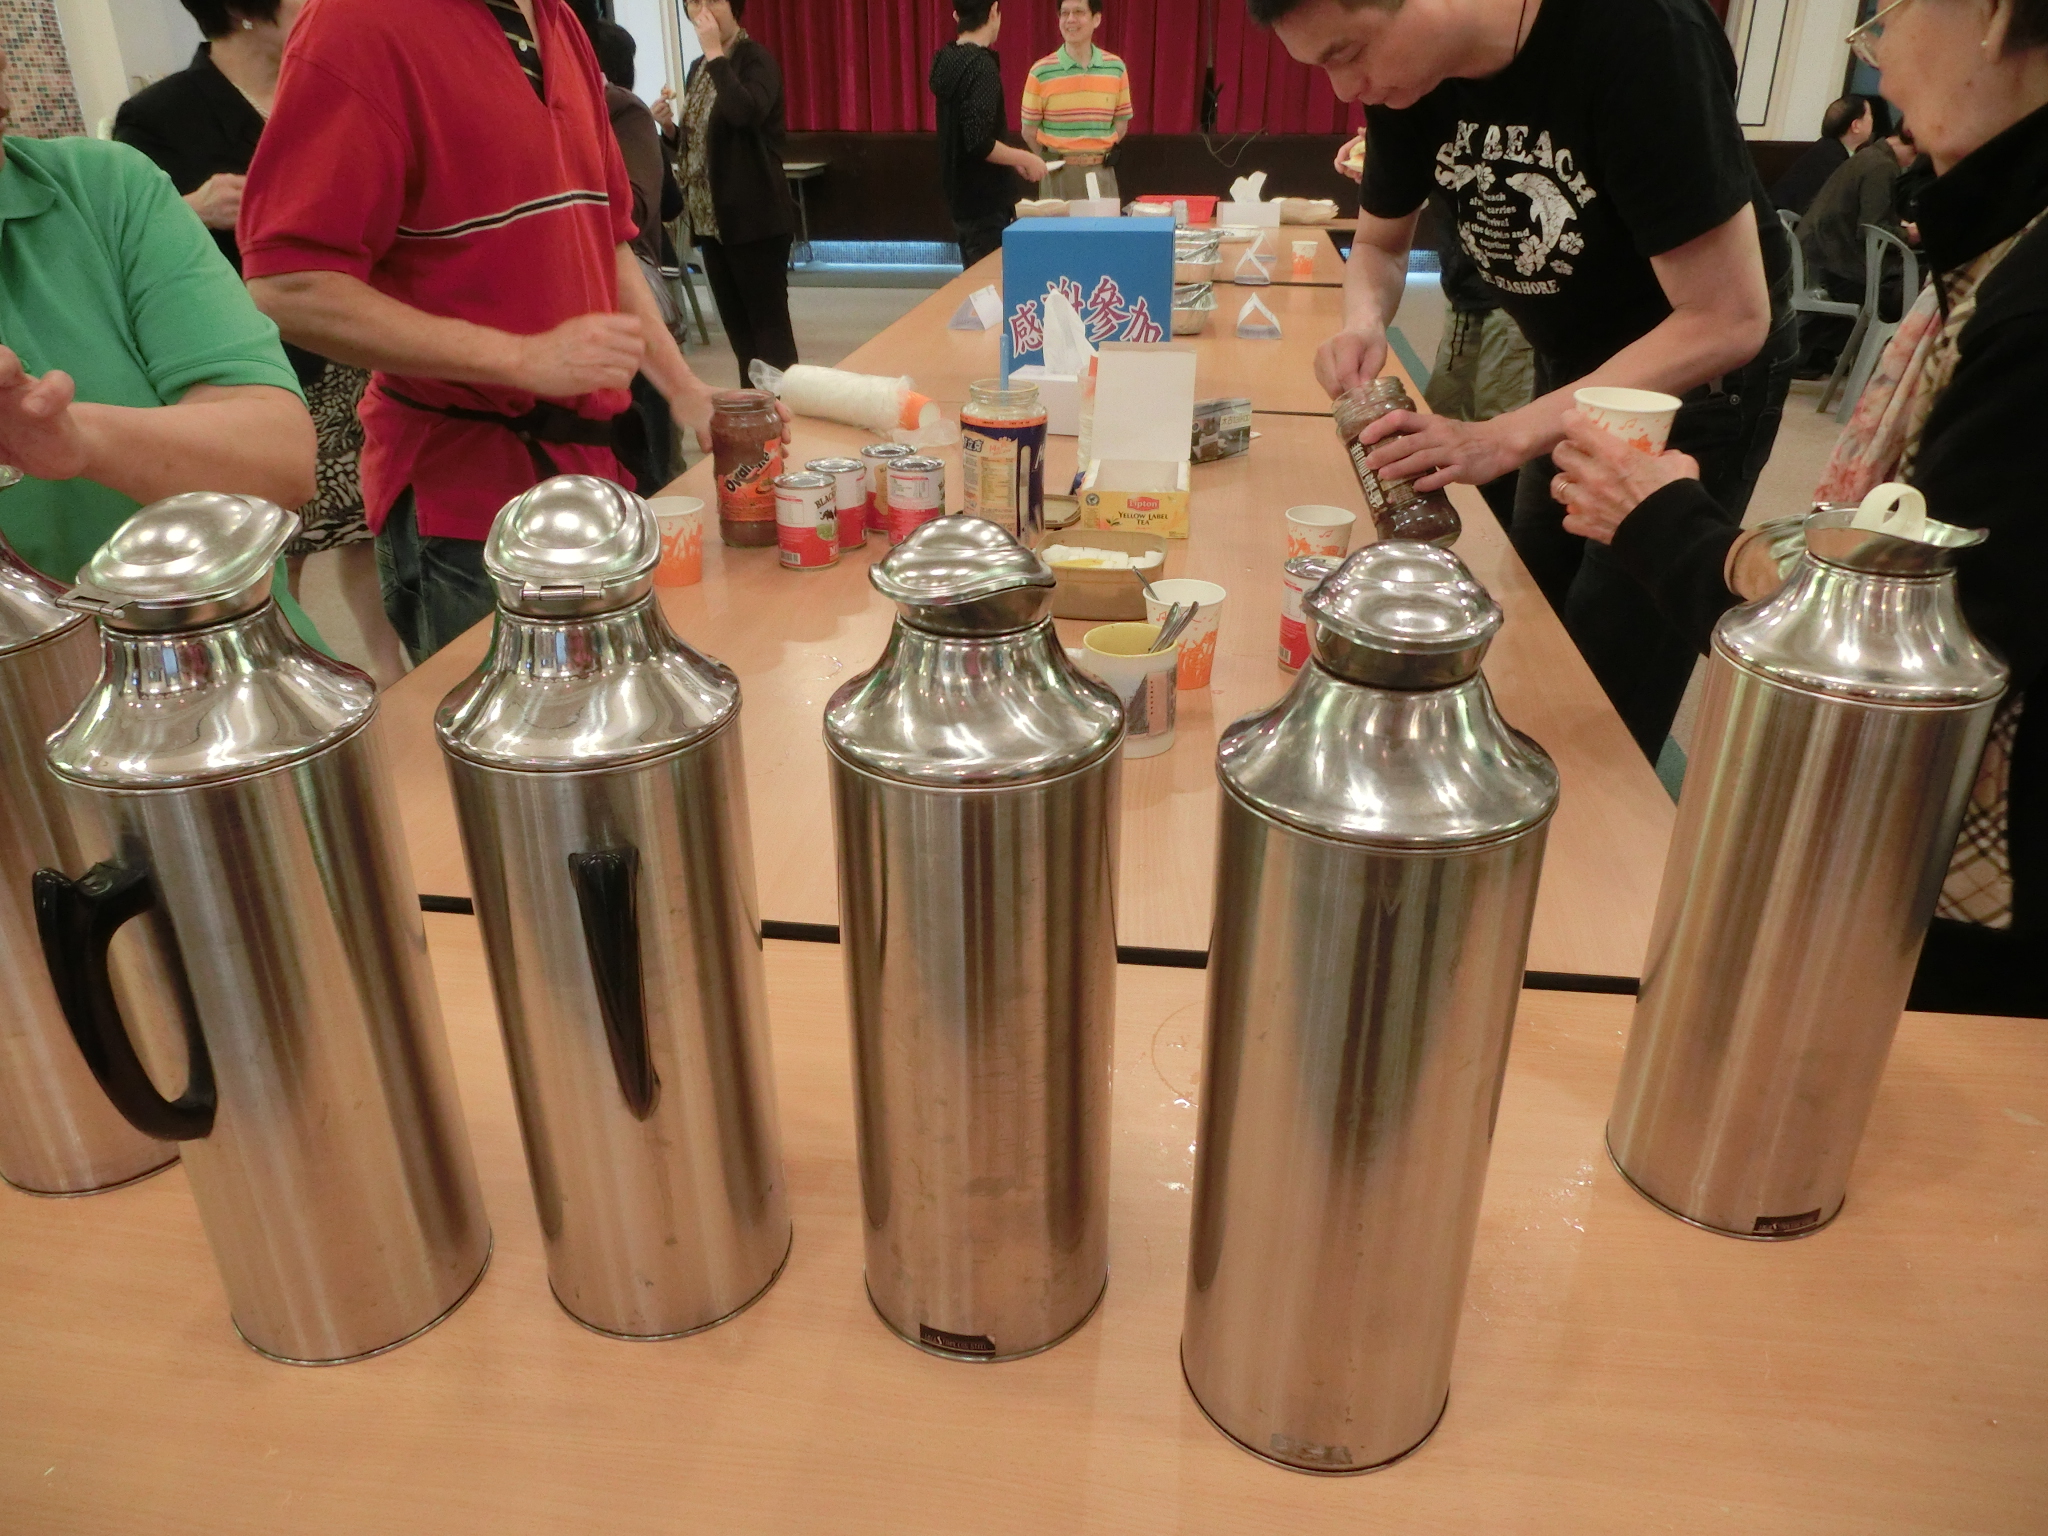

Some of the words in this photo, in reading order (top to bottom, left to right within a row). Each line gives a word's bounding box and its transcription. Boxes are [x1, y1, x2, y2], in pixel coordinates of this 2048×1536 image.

[1471, 223, 1484, 233] the
[1511, 227, 1530, 238] and
[726, 451, 770, 493] Ovaline
[1129, 499, 1158, 508] Lipton
[1118, 511, 1146, 519] YELLOW
[1148, 513, 1168, 521] LABEL
